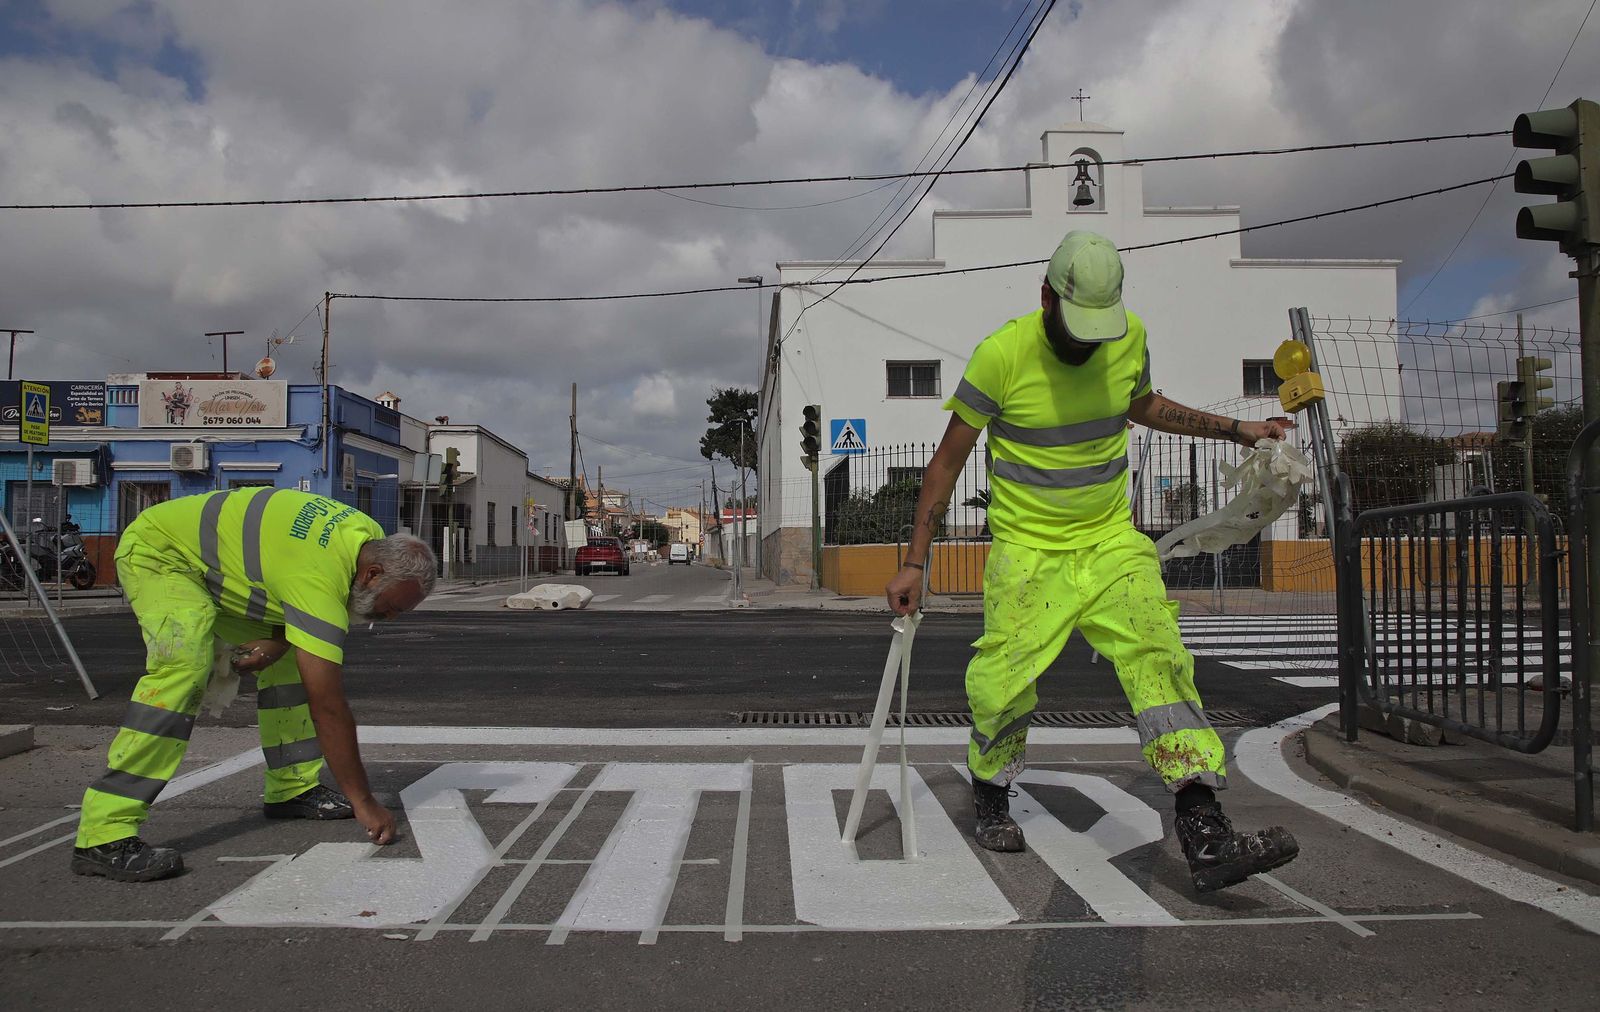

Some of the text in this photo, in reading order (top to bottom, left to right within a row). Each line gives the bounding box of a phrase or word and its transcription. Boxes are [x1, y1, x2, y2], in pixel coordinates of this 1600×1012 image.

[23, 384, 49, 394] ATENCIÓN
[208, 416, 261, 425] 679 060 044
[207, 759, 1179, 929] STOP
